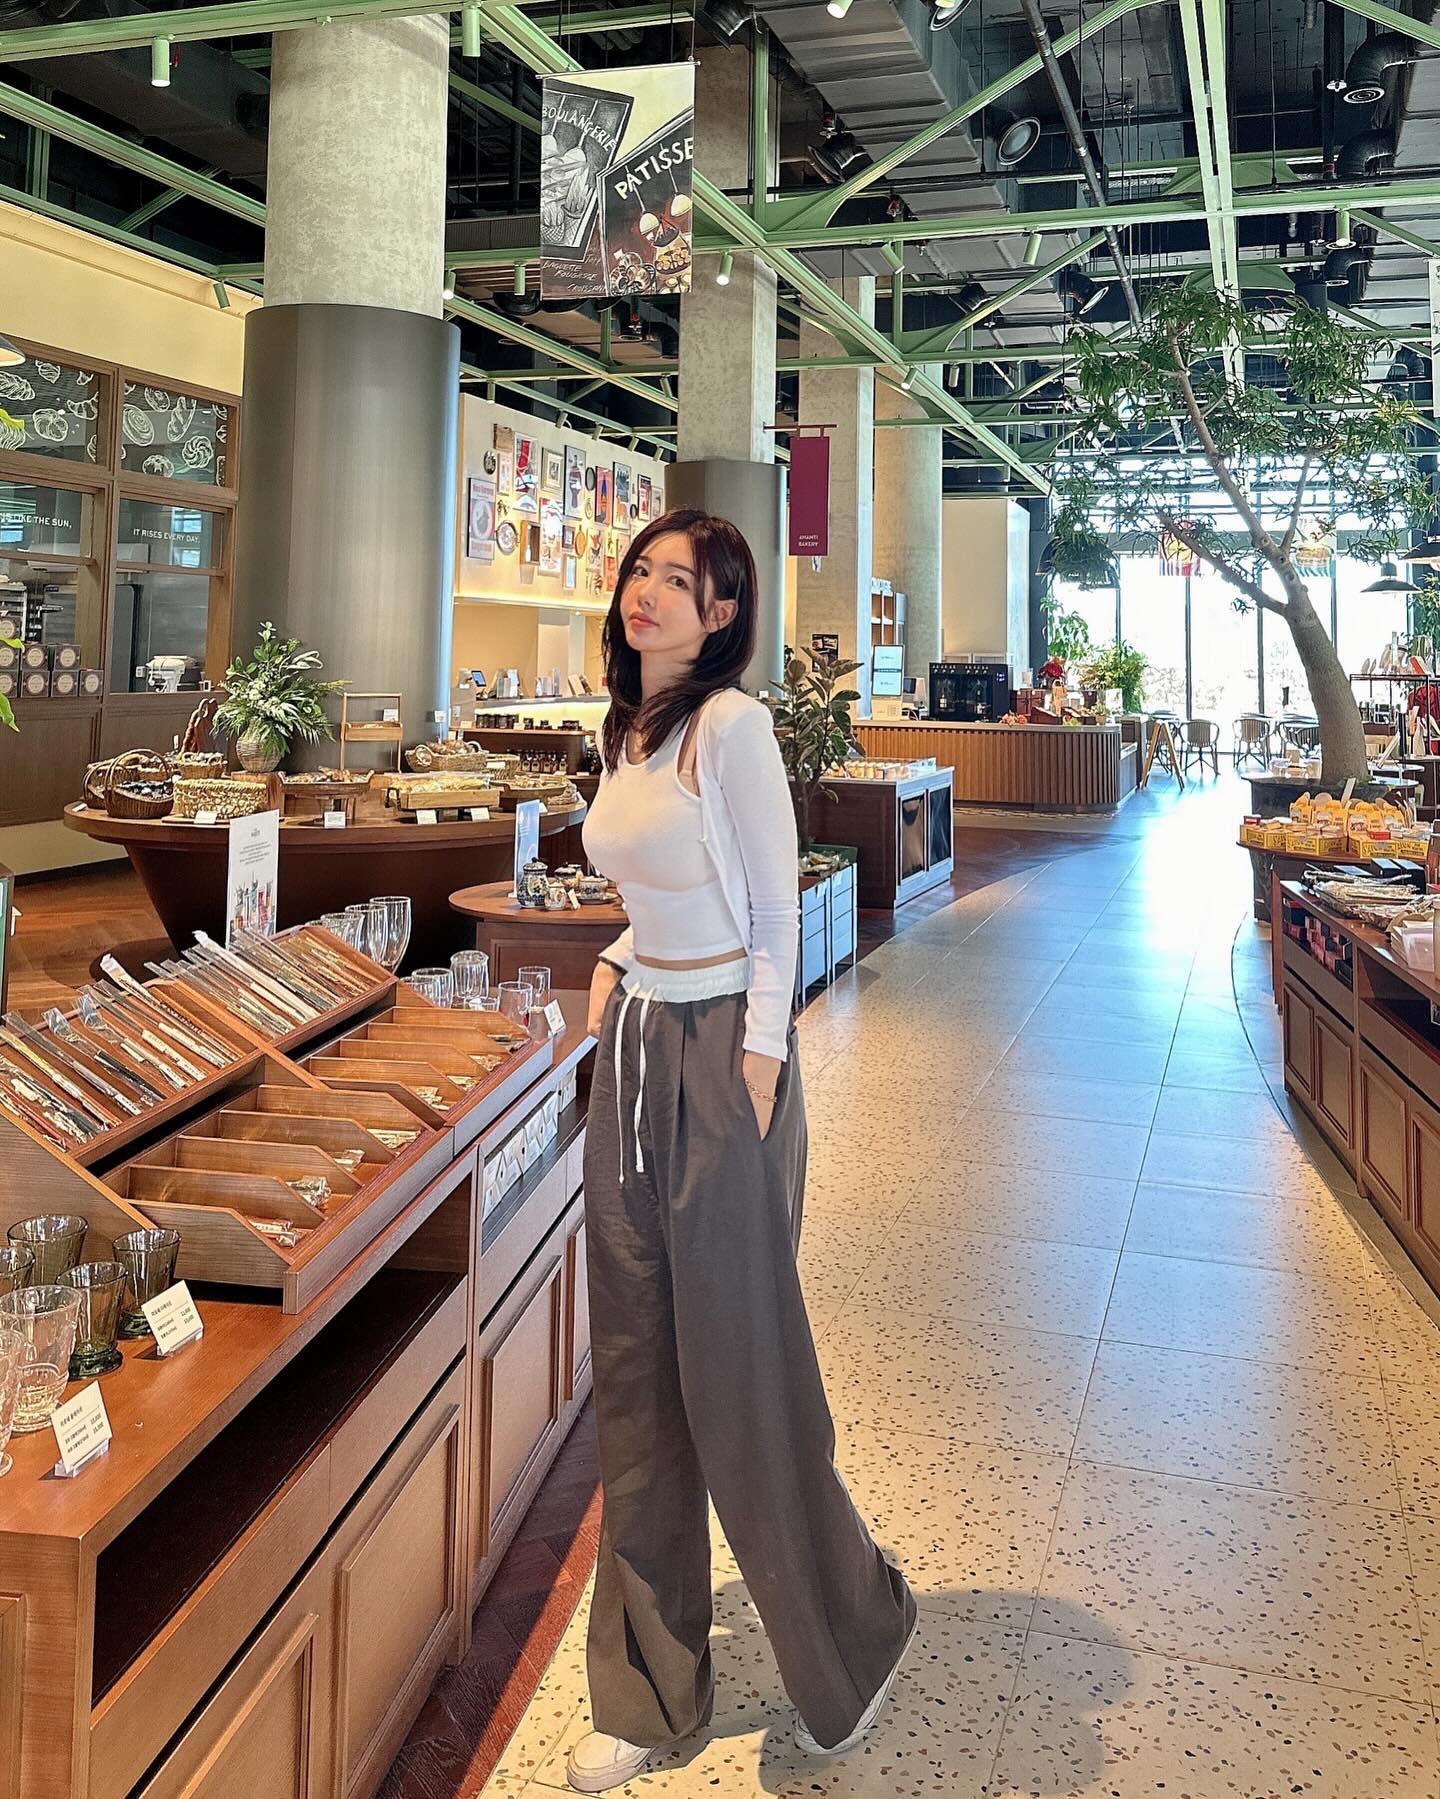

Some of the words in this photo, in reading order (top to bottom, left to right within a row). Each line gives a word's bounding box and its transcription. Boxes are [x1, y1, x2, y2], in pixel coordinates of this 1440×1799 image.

[33, 516, 50, 525] THE
[51, 518, 72, 529] SUN,
[133, 528, 141, 536] IT
[141, 529, 162, 539] RISES
[163, 532, 185, 541] EVERY
